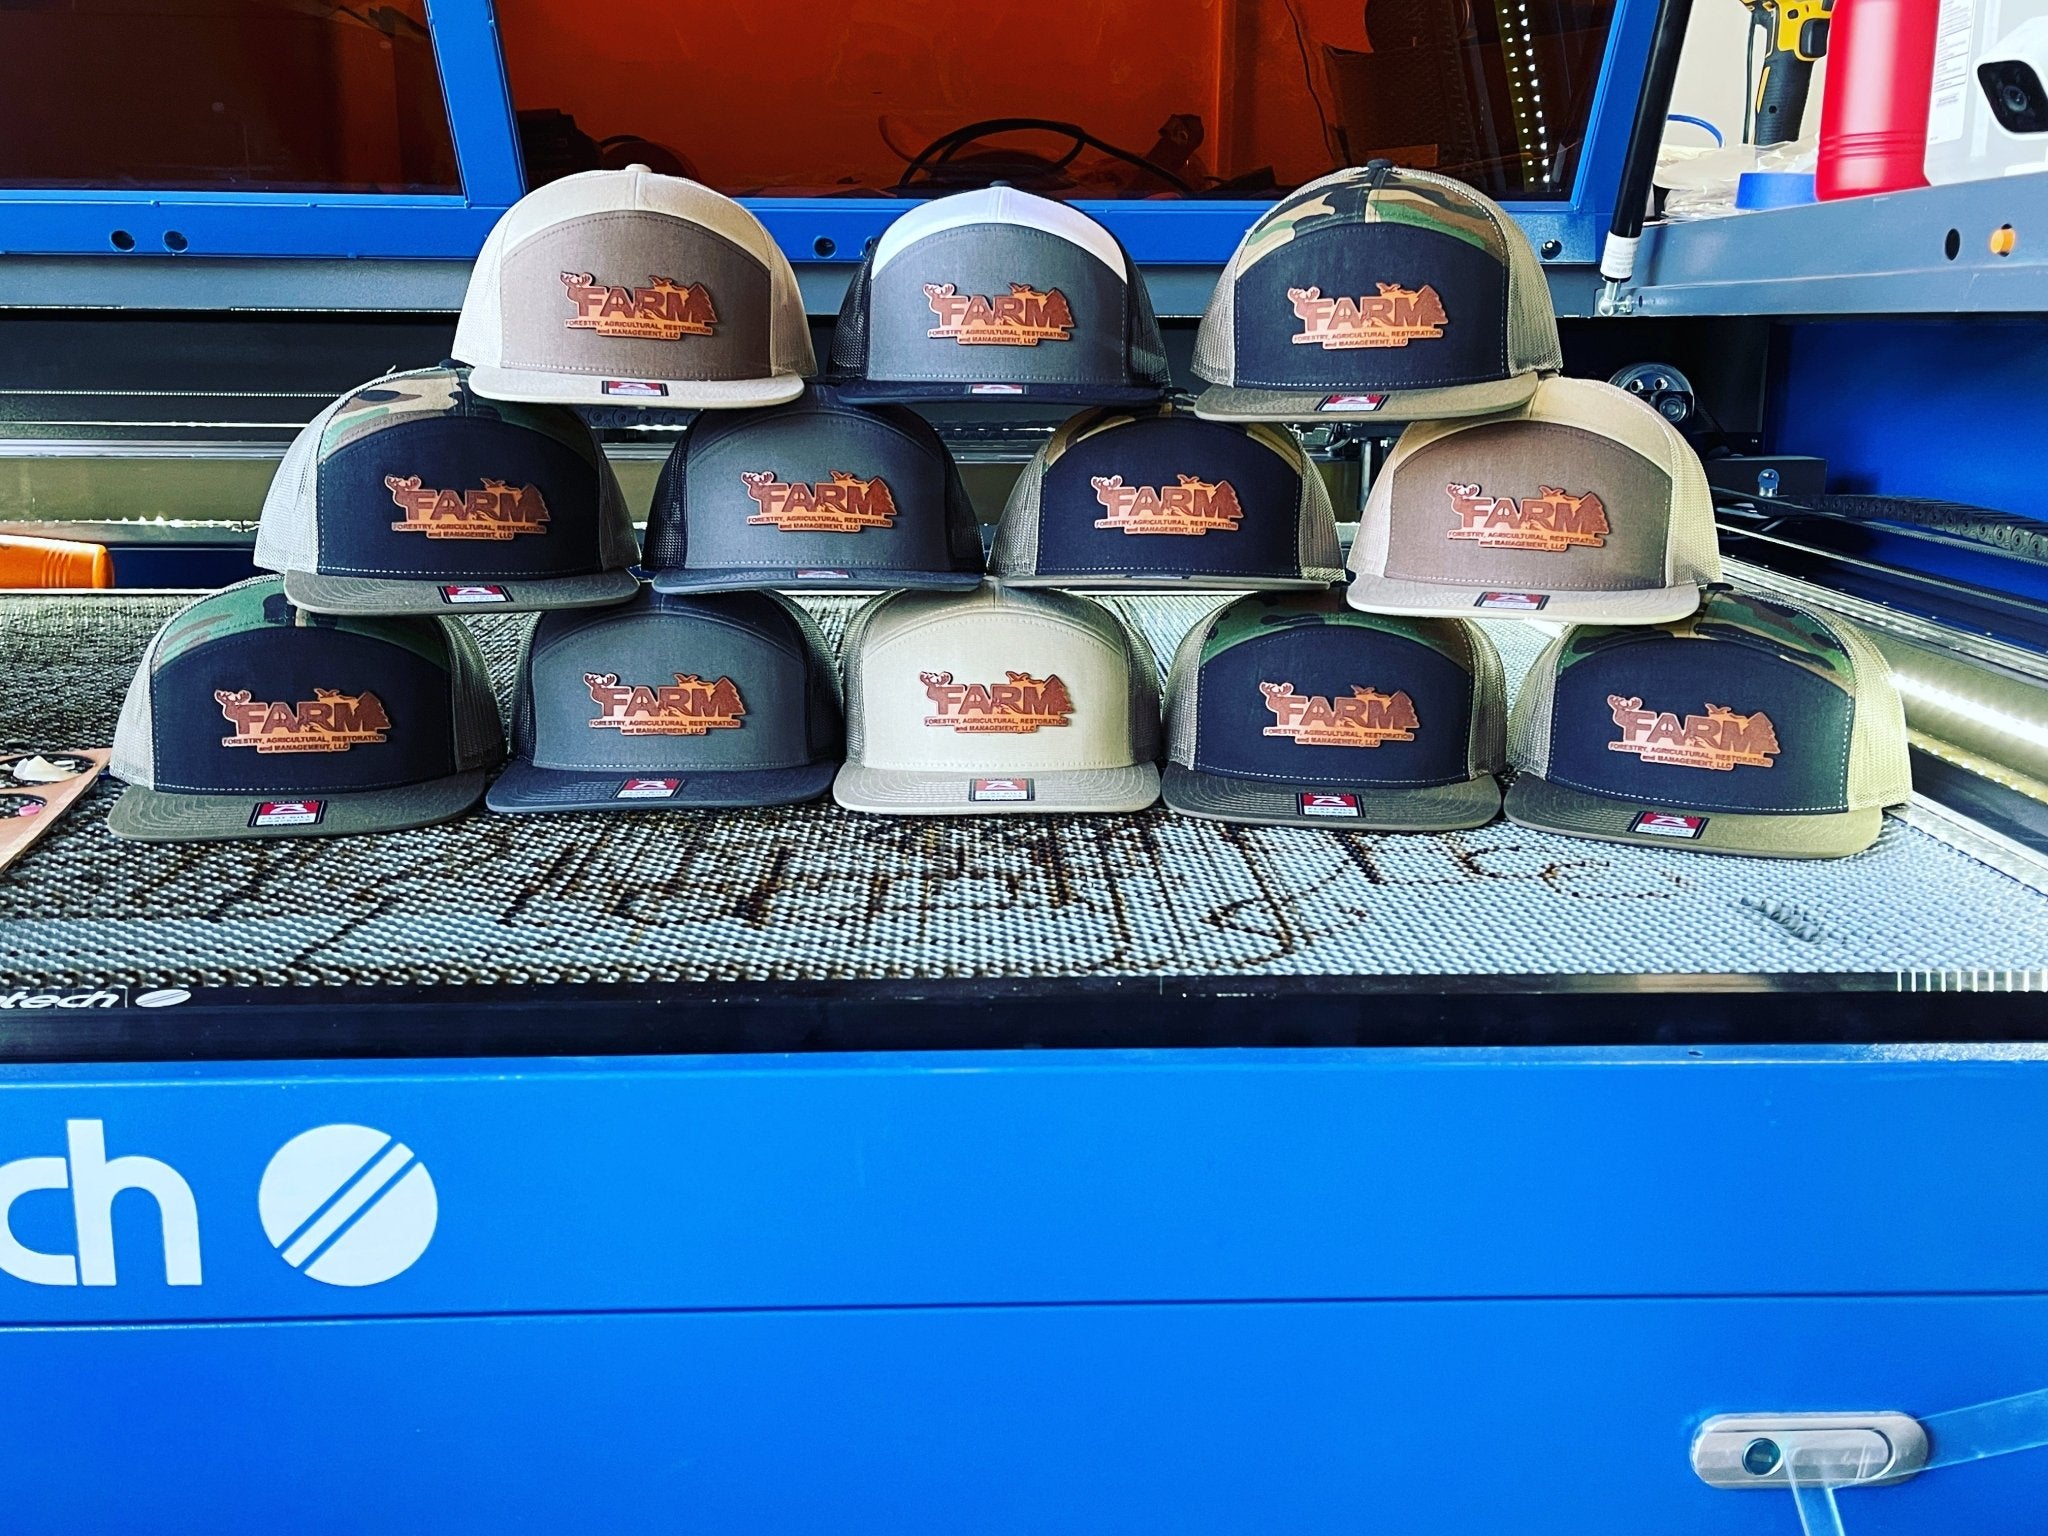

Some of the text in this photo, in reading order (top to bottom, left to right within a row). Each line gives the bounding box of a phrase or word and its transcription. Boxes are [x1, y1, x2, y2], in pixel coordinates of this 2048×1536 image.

[577, 285, 717, 323] FARM
[940, 290, 1074, 328] FARM
[1305, 285, 1448, 331] FARM
[664, 324, 712, 333] RESTORATION
[406, 485, 550, 522] FARM
[760, 479, 897, 515] FARM
[1108, 481, 1243, 518] FARM
[1462, 493, 1609, 533] FARM
[844, 518, 891, 526] RESTORATION
[1550, 535, 1602, 545] RESTORATION
[237, 692, 390, 734] FARM
[602, 678, 745, 717] FARM
[937, 675, 1072, 715] FARM
[1278, 692, 1419, 728] FARM
[1624, 711, 1780, 754] FARM
[1716, 754, 1771, 765] RESTORATION
[1717, 761, 1732, 769] LLC
